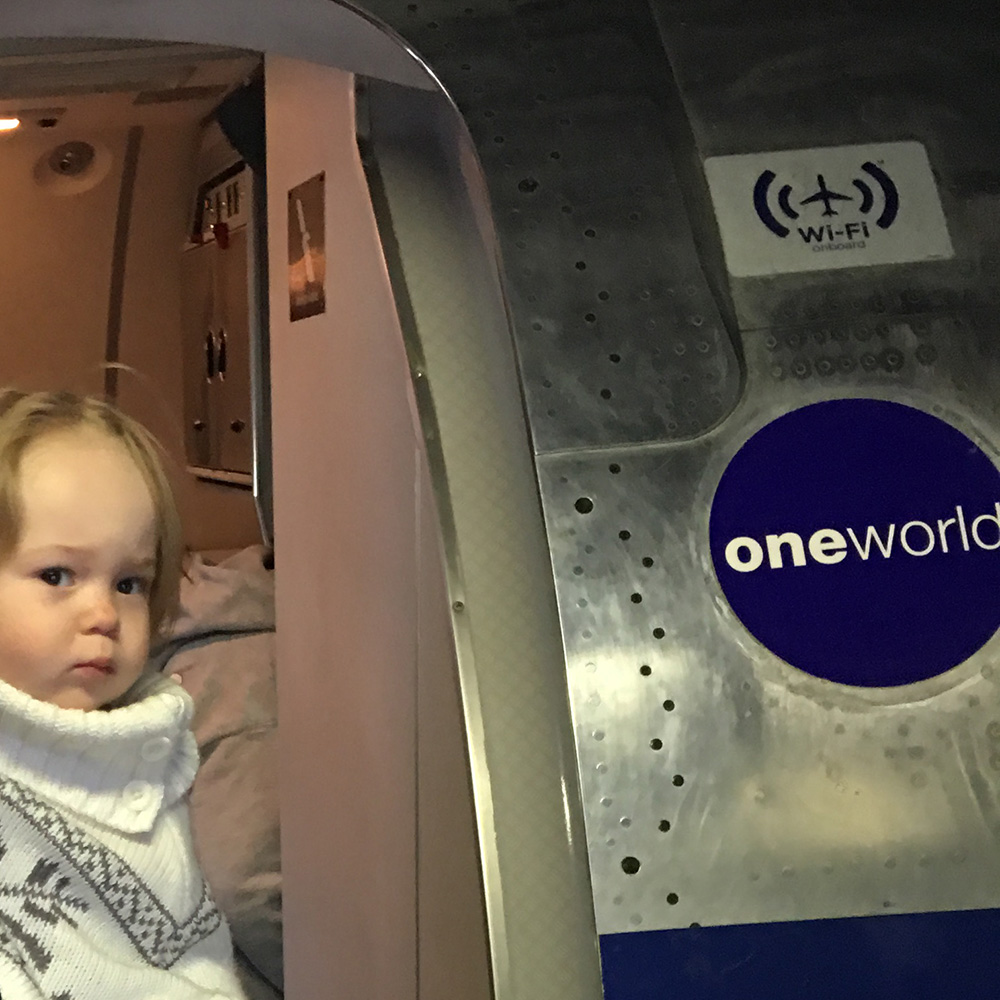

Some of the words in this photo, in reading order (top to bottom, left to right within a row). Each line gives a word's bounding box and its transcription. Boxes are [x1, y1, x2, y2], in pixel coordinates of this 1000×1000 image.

[798, 221, 870, 243] Wi-Fi
[812, 240, 866, 253] onboard
[724, 501, 1000, 573] oneworld
